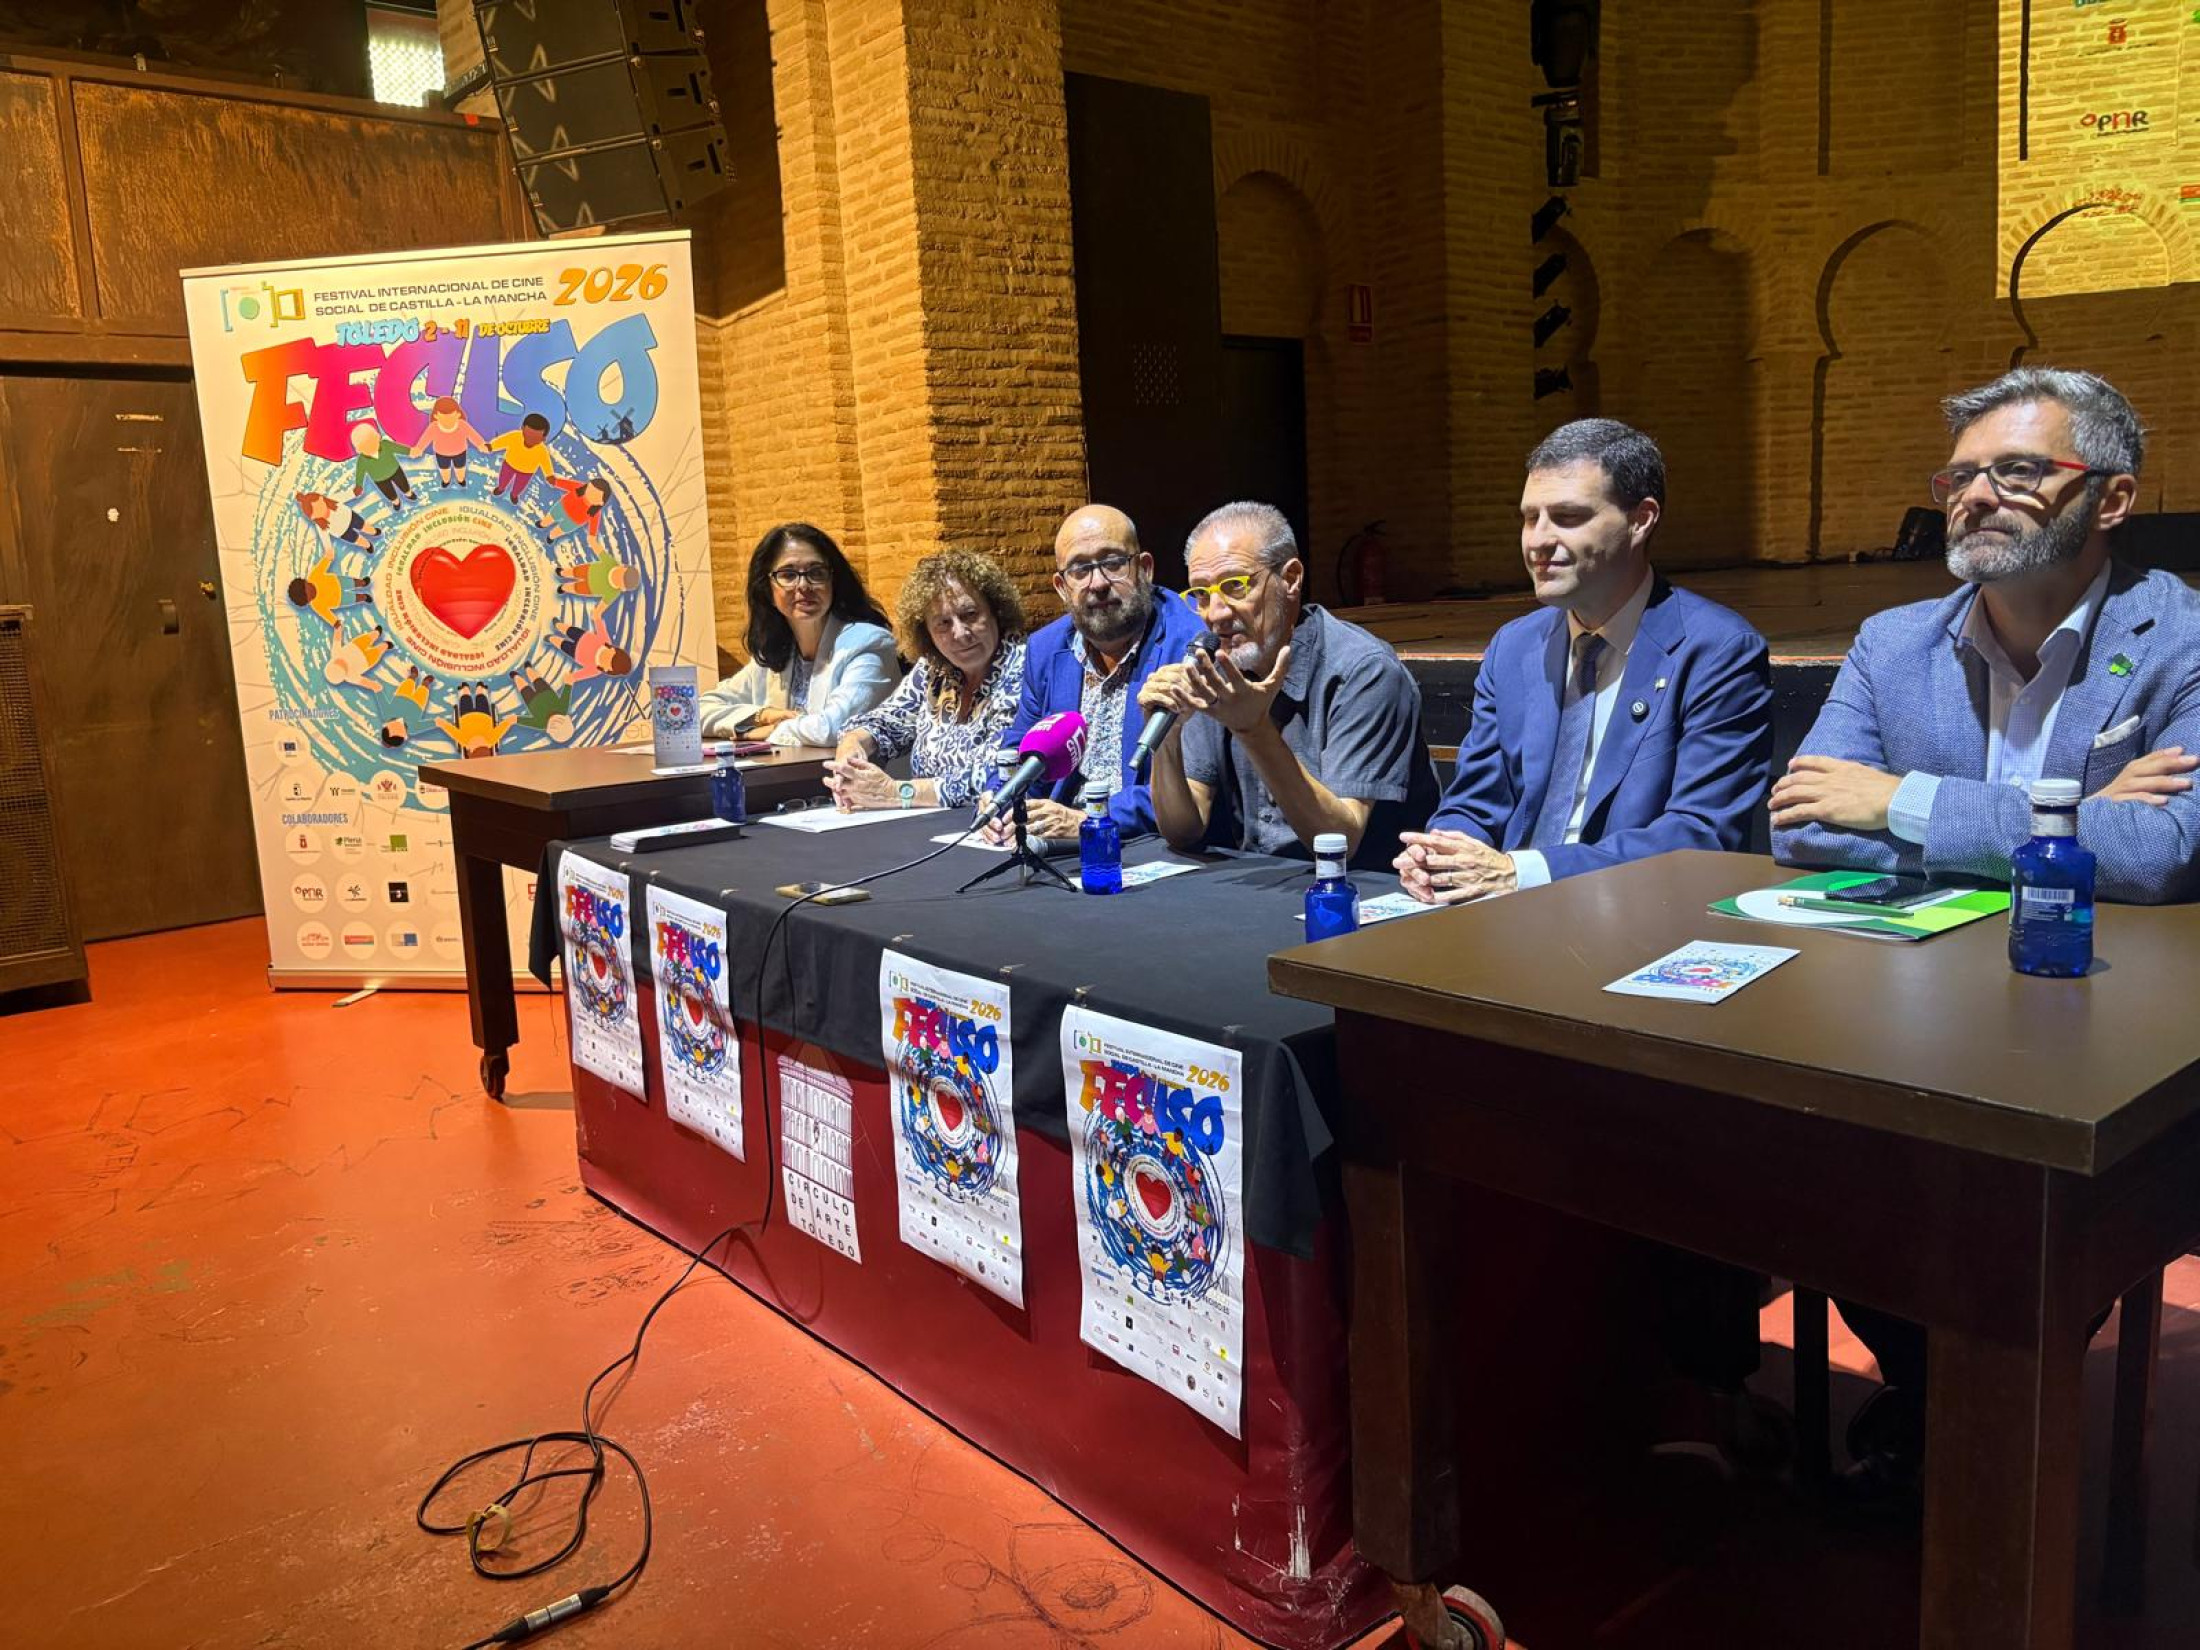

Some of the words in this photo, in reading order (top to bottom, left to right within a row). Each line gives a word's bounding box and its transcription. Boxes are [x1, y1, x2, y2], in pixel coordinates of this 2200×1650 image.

[314, 287, 375, 302] FESTIVAL
[378, 279, 488, 298] INTERNACIONAL
[491, 278, 509, 289] DE
[512, 277, 543, 288] CINE
[553, 263, 668, 306] 2026
[315, 302, 364, 316] SOCIAL
[369, 302, 387, 313] DE
[389, 296, 454, 311] CASTILLA
[463, 294, 481, 306] LA
[485, 291, 547, 304] MANCHA
[336, 316, 420, 347] TOLEDO
[424, 320, 437, 342] 2
[479, 322, 497, 338] DE
[497, 319, 551, 336] OCTUBRE
[241, 313, 659, 466] FECISO
[269, 708, 341, 721] PATROCINADORES
[281, 813, 349, 825] COLABORADORES
[970, 999, 1002, 1021] 2026
[1186, 1065, 1230, 1092] 2026
[791, 1193, 804, 1209] DE
[816, 1205, 852, 1236] ARTE
[801, 1217, 855, 1257] TOLEDO
